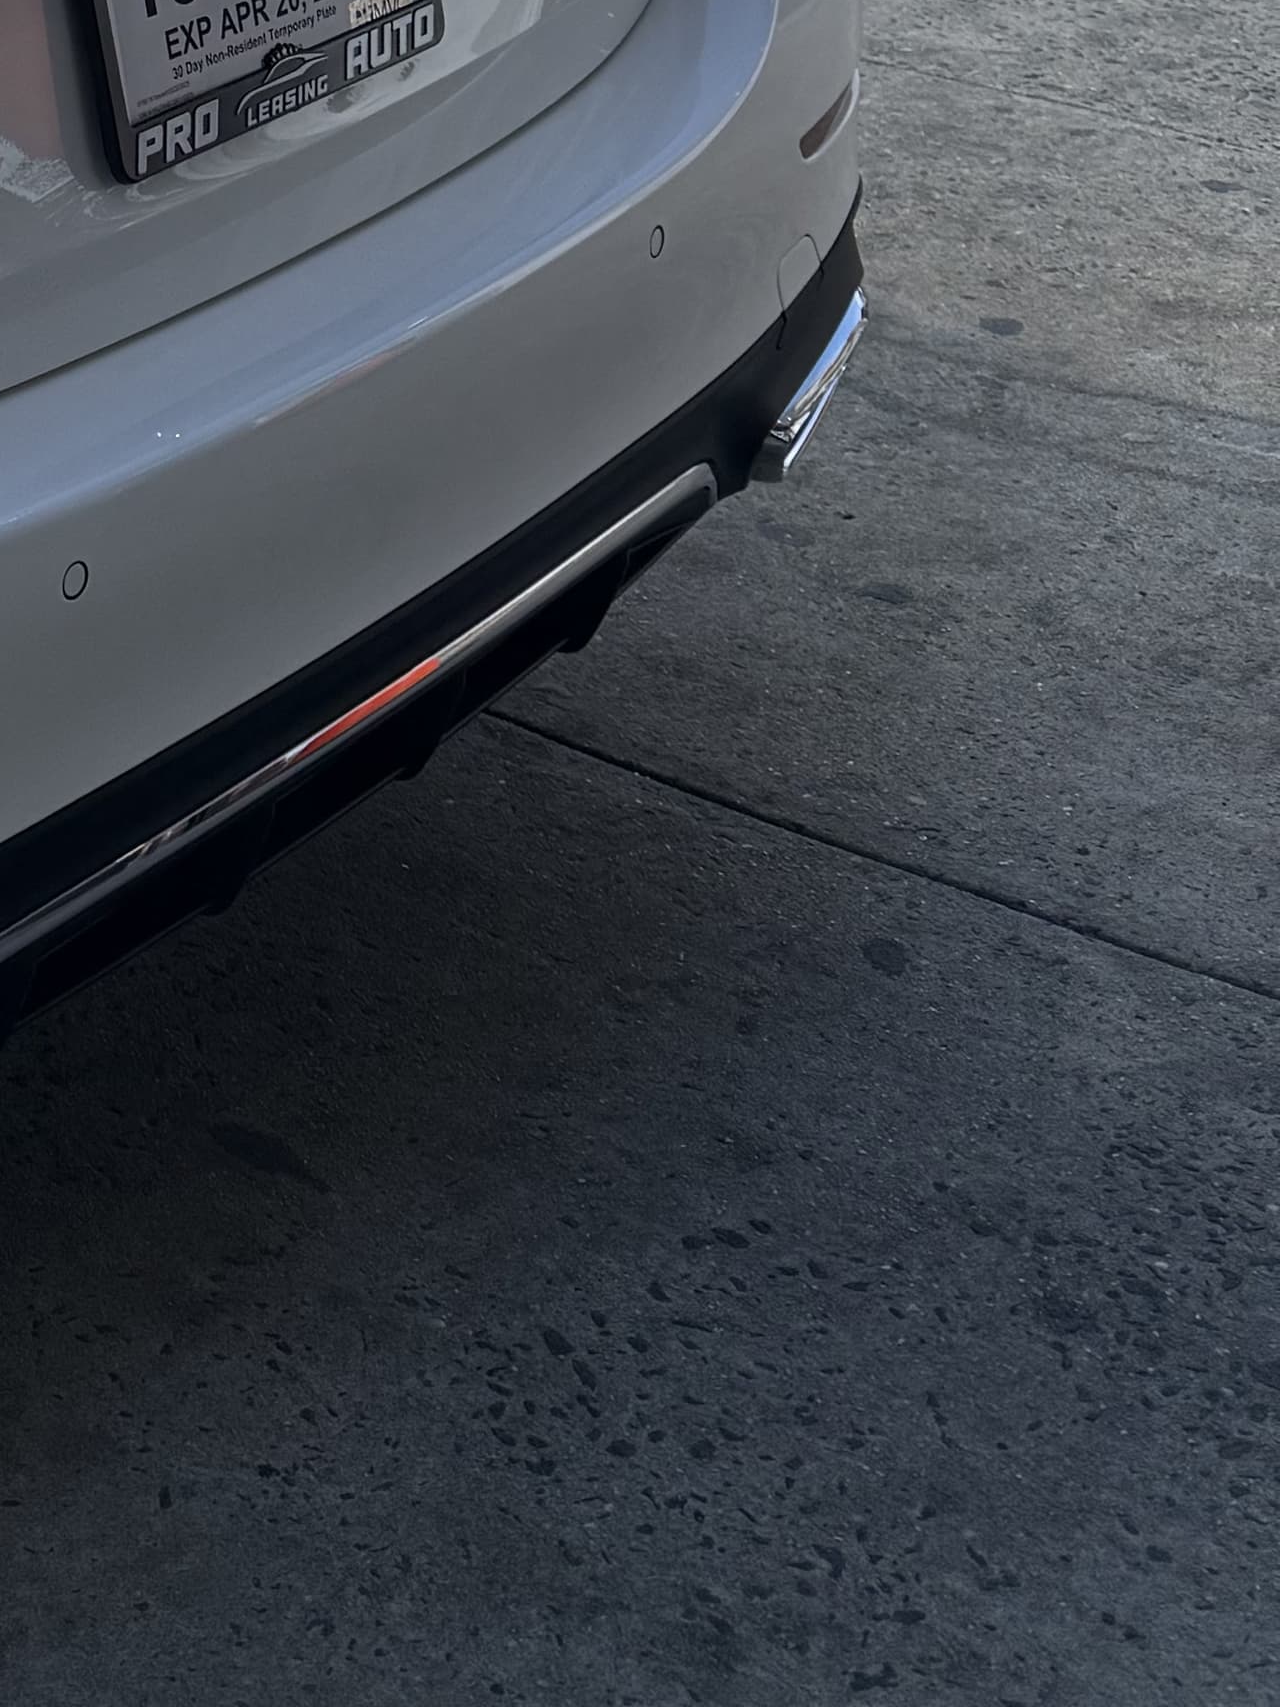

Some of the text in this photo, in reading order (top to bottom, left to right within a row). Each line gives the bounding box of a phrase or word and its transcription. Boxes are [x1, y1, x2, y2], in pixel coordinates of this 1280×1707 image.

[165, 16, 212, 61] EXP
[171, 5, 337, 80] 30 Day Non-Resident Temporary Plate
[137, 98, 220, 176] PRO
[245, 74, 329, 128] LEASING
[345, 3, 435, 82] AUTO
